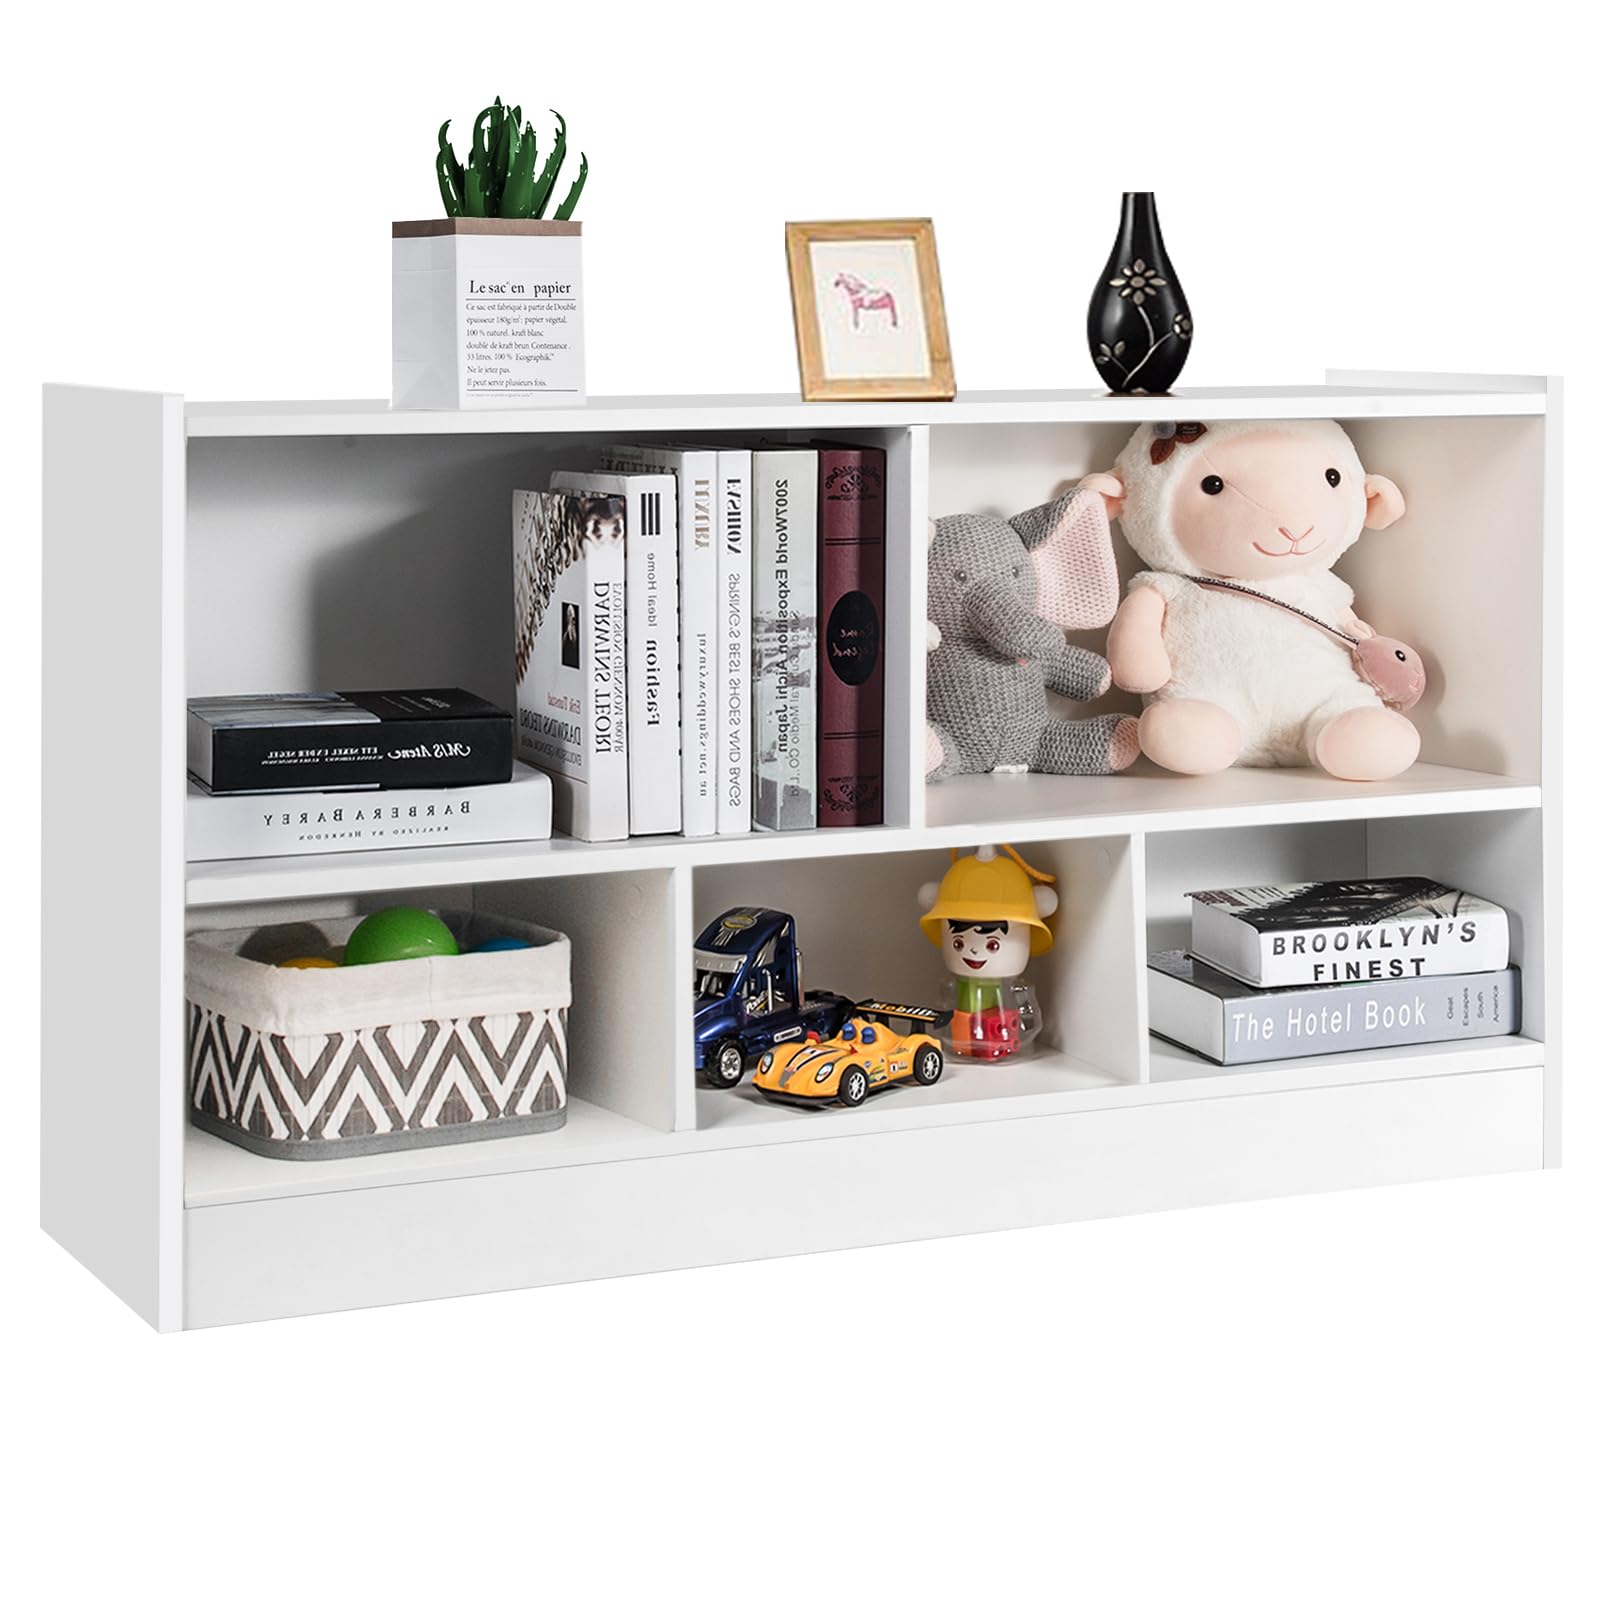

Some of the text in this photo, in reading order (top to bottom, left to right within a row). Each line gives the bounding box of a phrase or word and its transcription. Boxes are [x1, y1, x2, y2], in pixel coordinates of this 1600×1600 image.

[470, 281, 485, 293] Le
[511, 285, 524, 293] en
[534, 282, 571, 297] papier
[528, 304, 544, 312] partir
[506, 378, 533, 388] plusieurs
[1313, 957, 1426, 981] FINEST
[1232, 996, 1426, 1042] The Hotel Book
